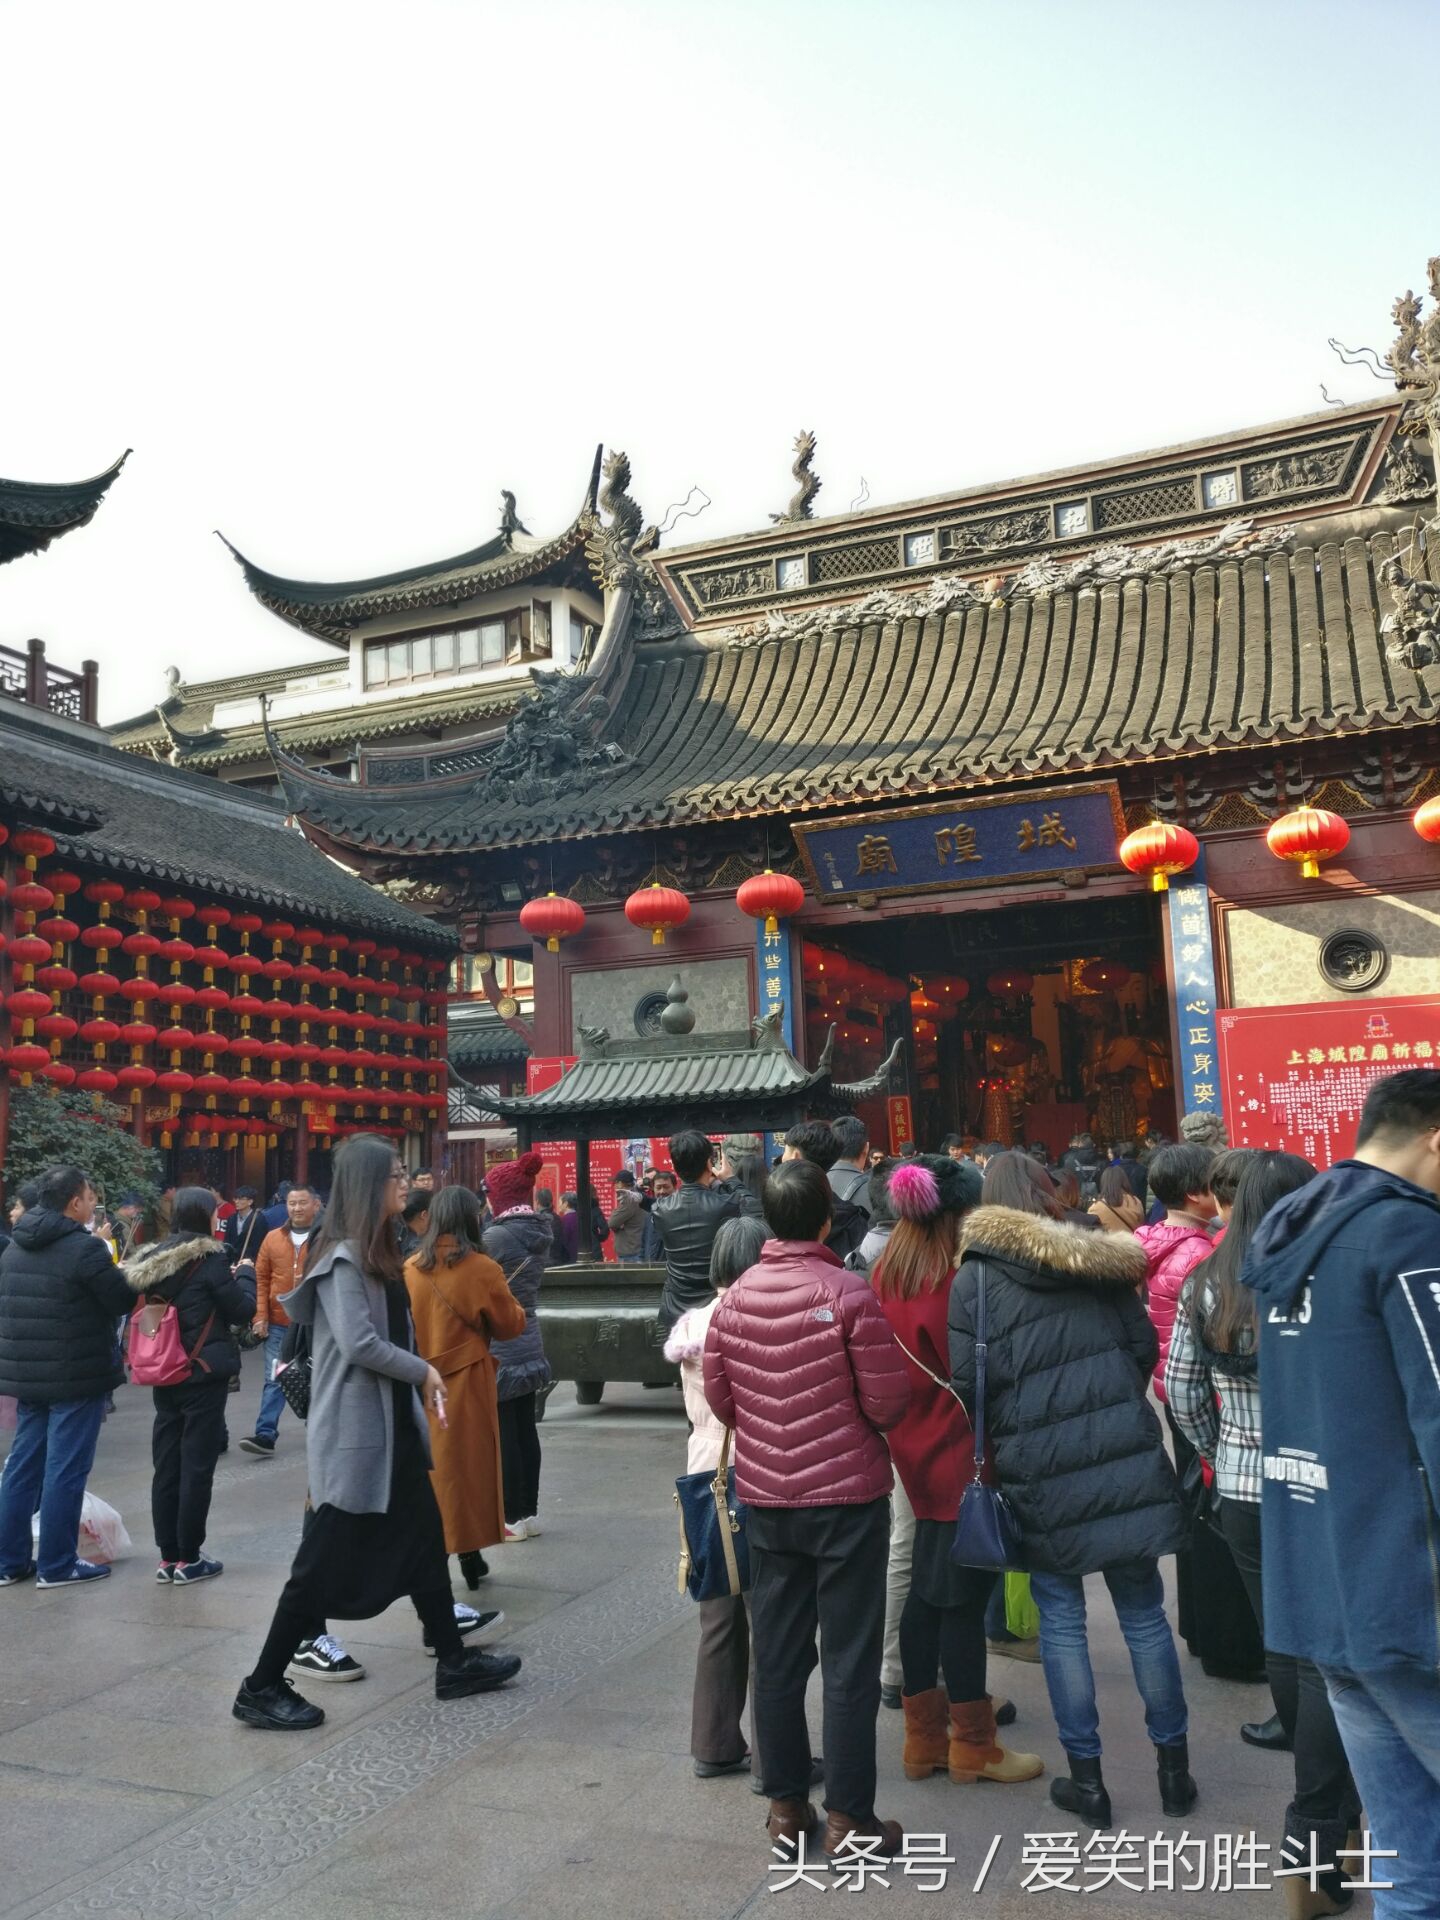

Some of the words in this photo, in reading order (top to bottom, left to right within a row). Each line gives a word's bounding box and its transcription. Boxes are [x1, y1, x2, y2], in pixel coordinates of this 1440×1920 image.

[1287, 1040, 1440, 1065] 上海城隍廟祈福
